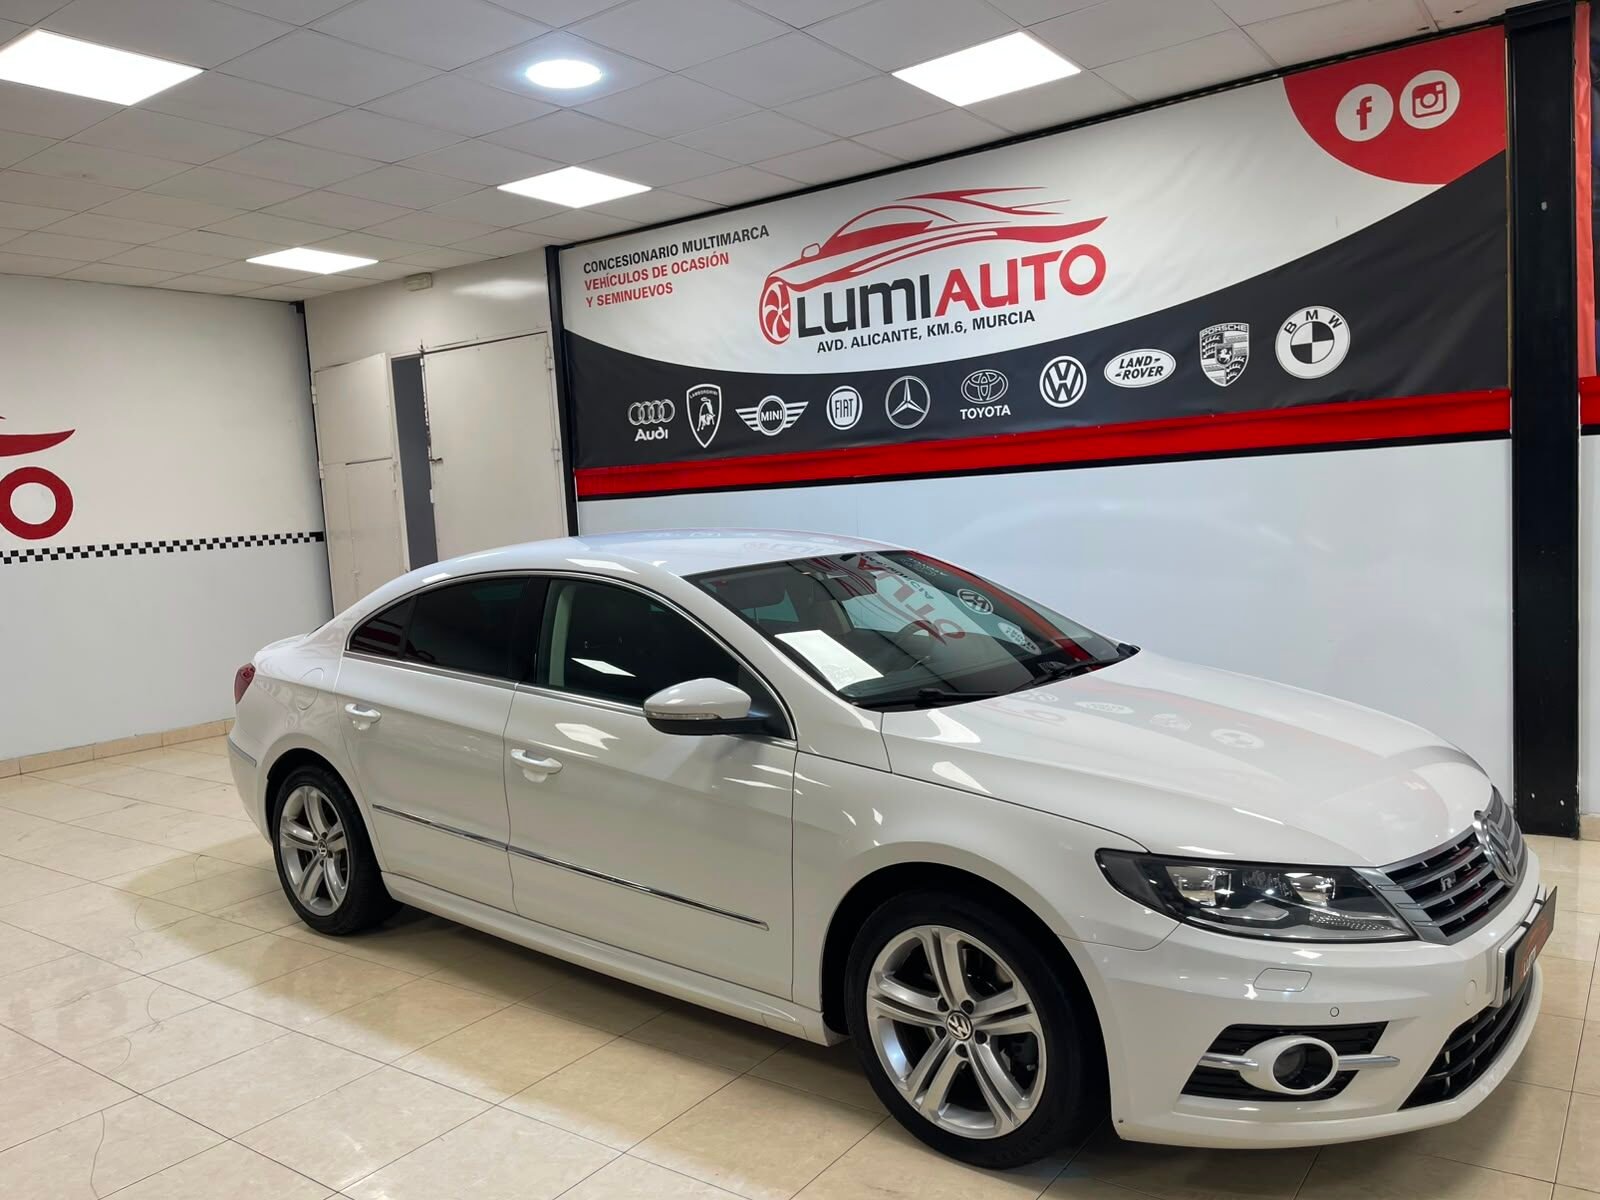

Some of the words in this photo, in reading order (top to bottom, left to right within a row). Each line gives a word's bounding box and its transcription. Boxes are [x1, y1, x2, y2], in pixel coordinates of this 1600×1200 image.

[583, 244, 679, 274] CONCESIONARIO
[682, 225, 769, 254] MULTIMARCA
[585, 268, 649, 291] VEHÍCULOS
[652, 265, 668, 279] DE
[671, 251, 729, 274] OCASIÓN
[586, 297, 593, 308] Y
[597, 282, 673, 306] SEMINUEVOS
[817, 340, 847, 353] AVD.
[851, 328, 922, 349] ALICANTE,
[972, 310, 1035, 331] MURCIA
[1201, 324, 1248, 338] PORSCHE
[1284, 309, 1343, 335] BMW
[760, 409, 783, 422] MINI
[835, 398, 854, 419] FIAT
[960, 404, 1011, 420] TOYOTA
[634, 426, 669, 442] Audi
